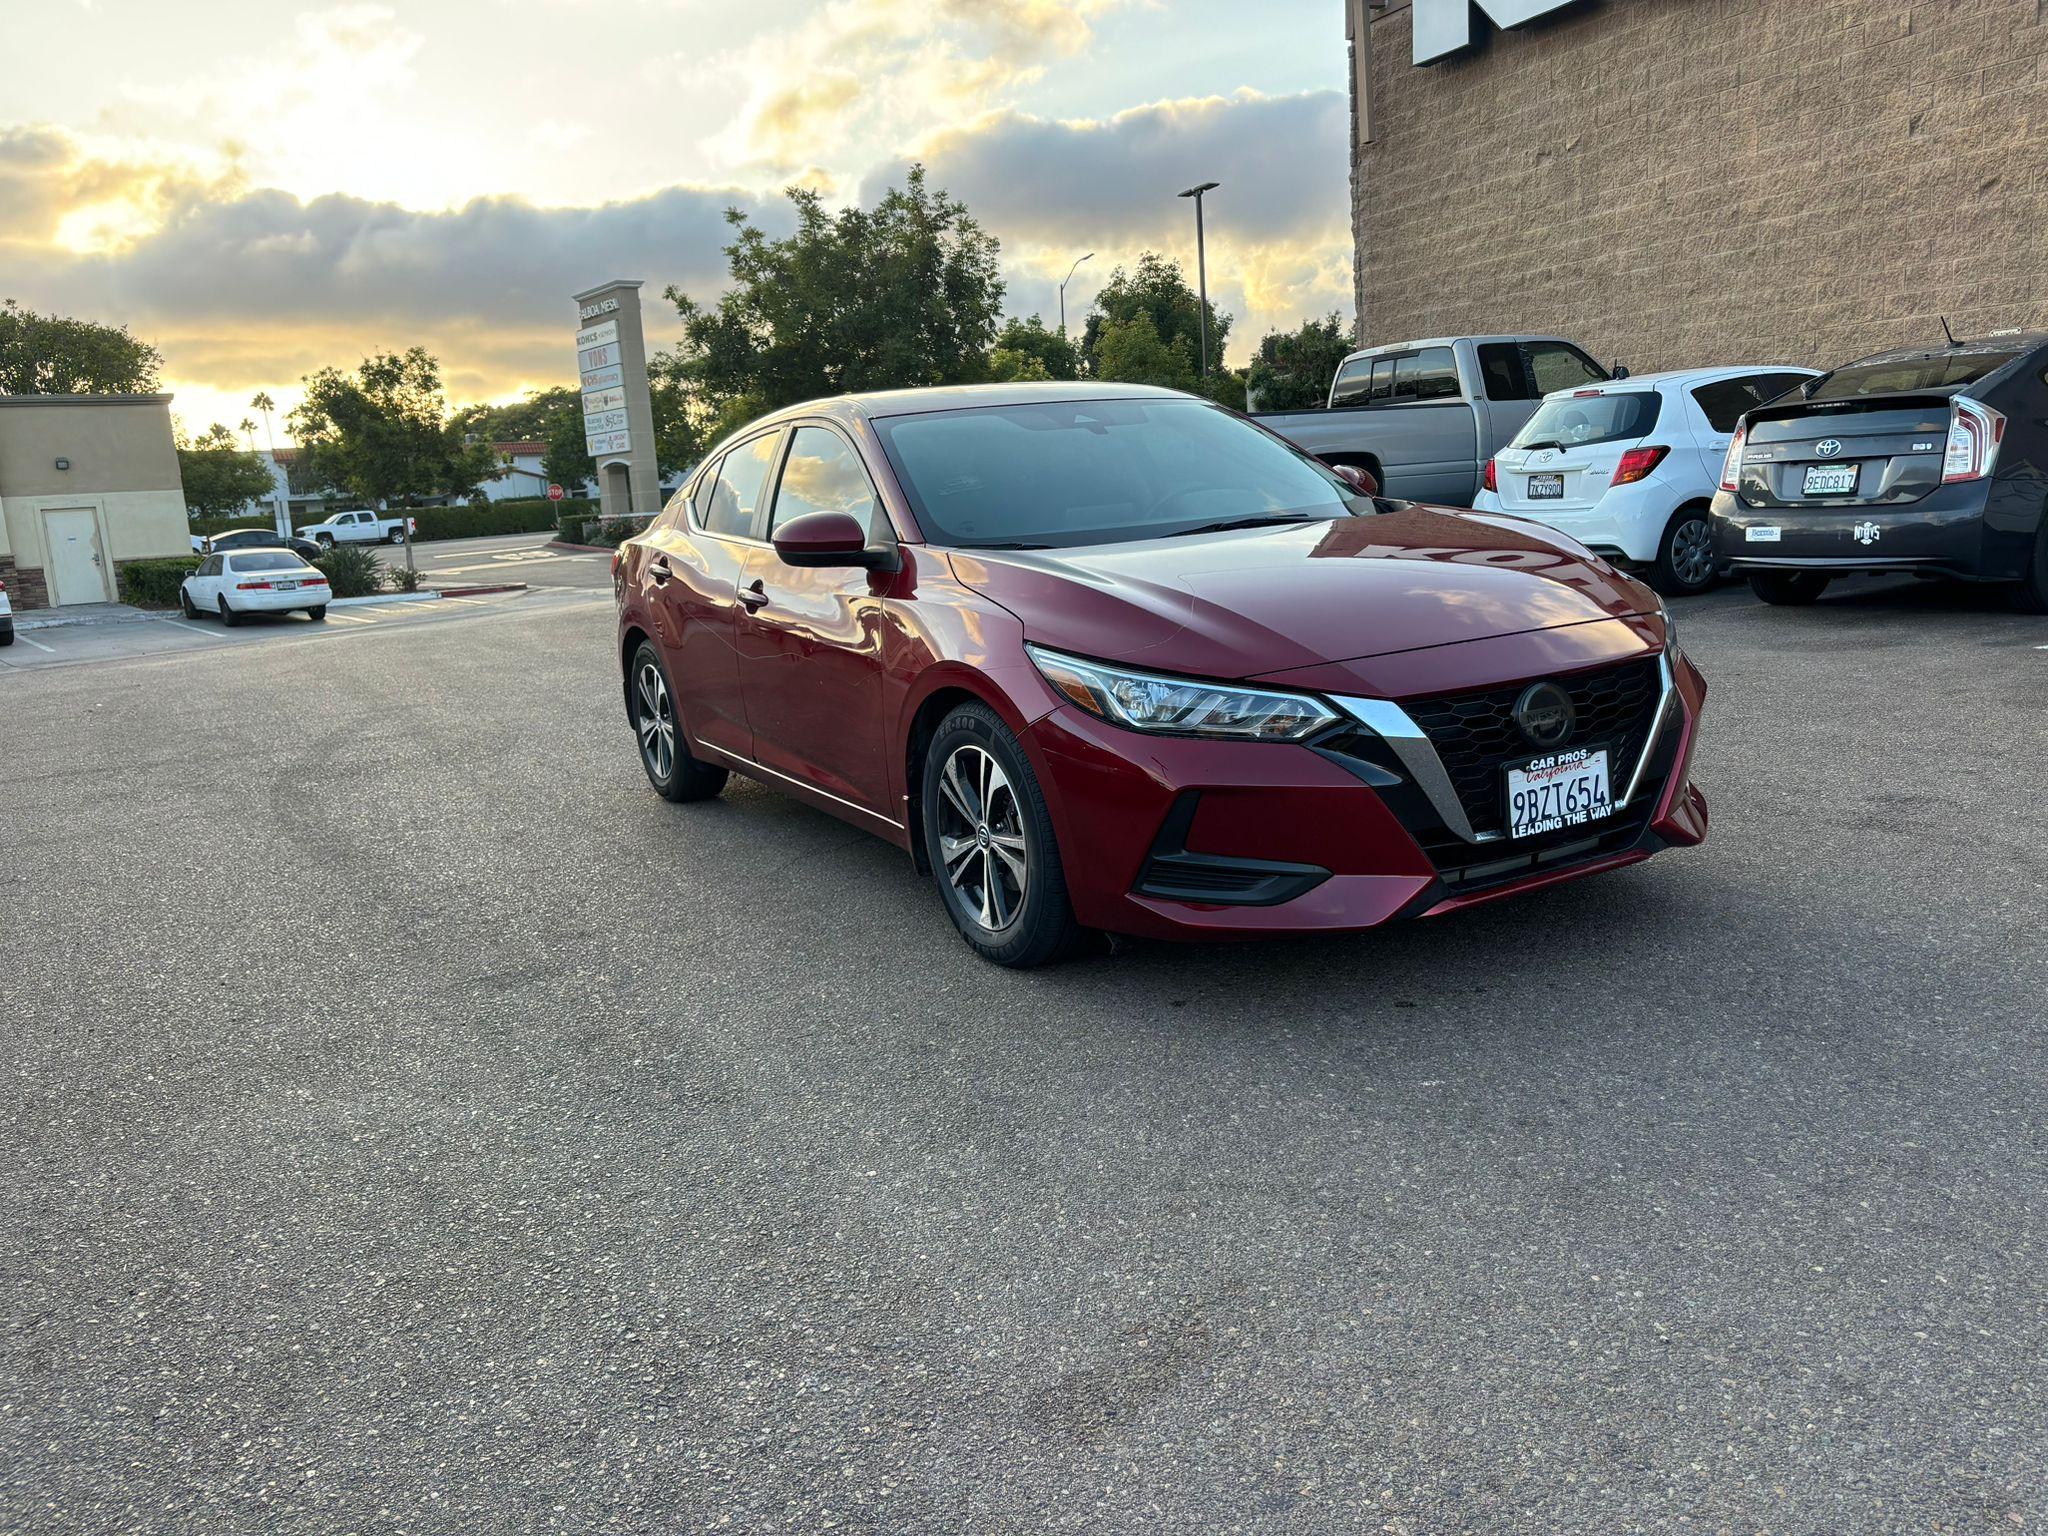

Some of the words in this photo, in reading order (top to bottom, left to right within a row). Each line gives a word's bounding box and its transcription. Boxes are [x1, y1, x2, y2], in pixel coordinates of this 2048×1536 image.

[588, 348, 608, 368] VONS
[548, 488, 562, 496] STOP
[1807, 475, 1854, 490] 9EDC817
[1530, 757, 1555, 770] CAR
[1558, 749, 1588, 765] PROS
[1526, 761, 1591, 783] California
[1513, 774, 1606, 827] 9BZT654
[1512, 817, 1563, 839] LEADING
[1565, 810, 1588, 825] THE
[1590, 804, 1613, 820] WAY
